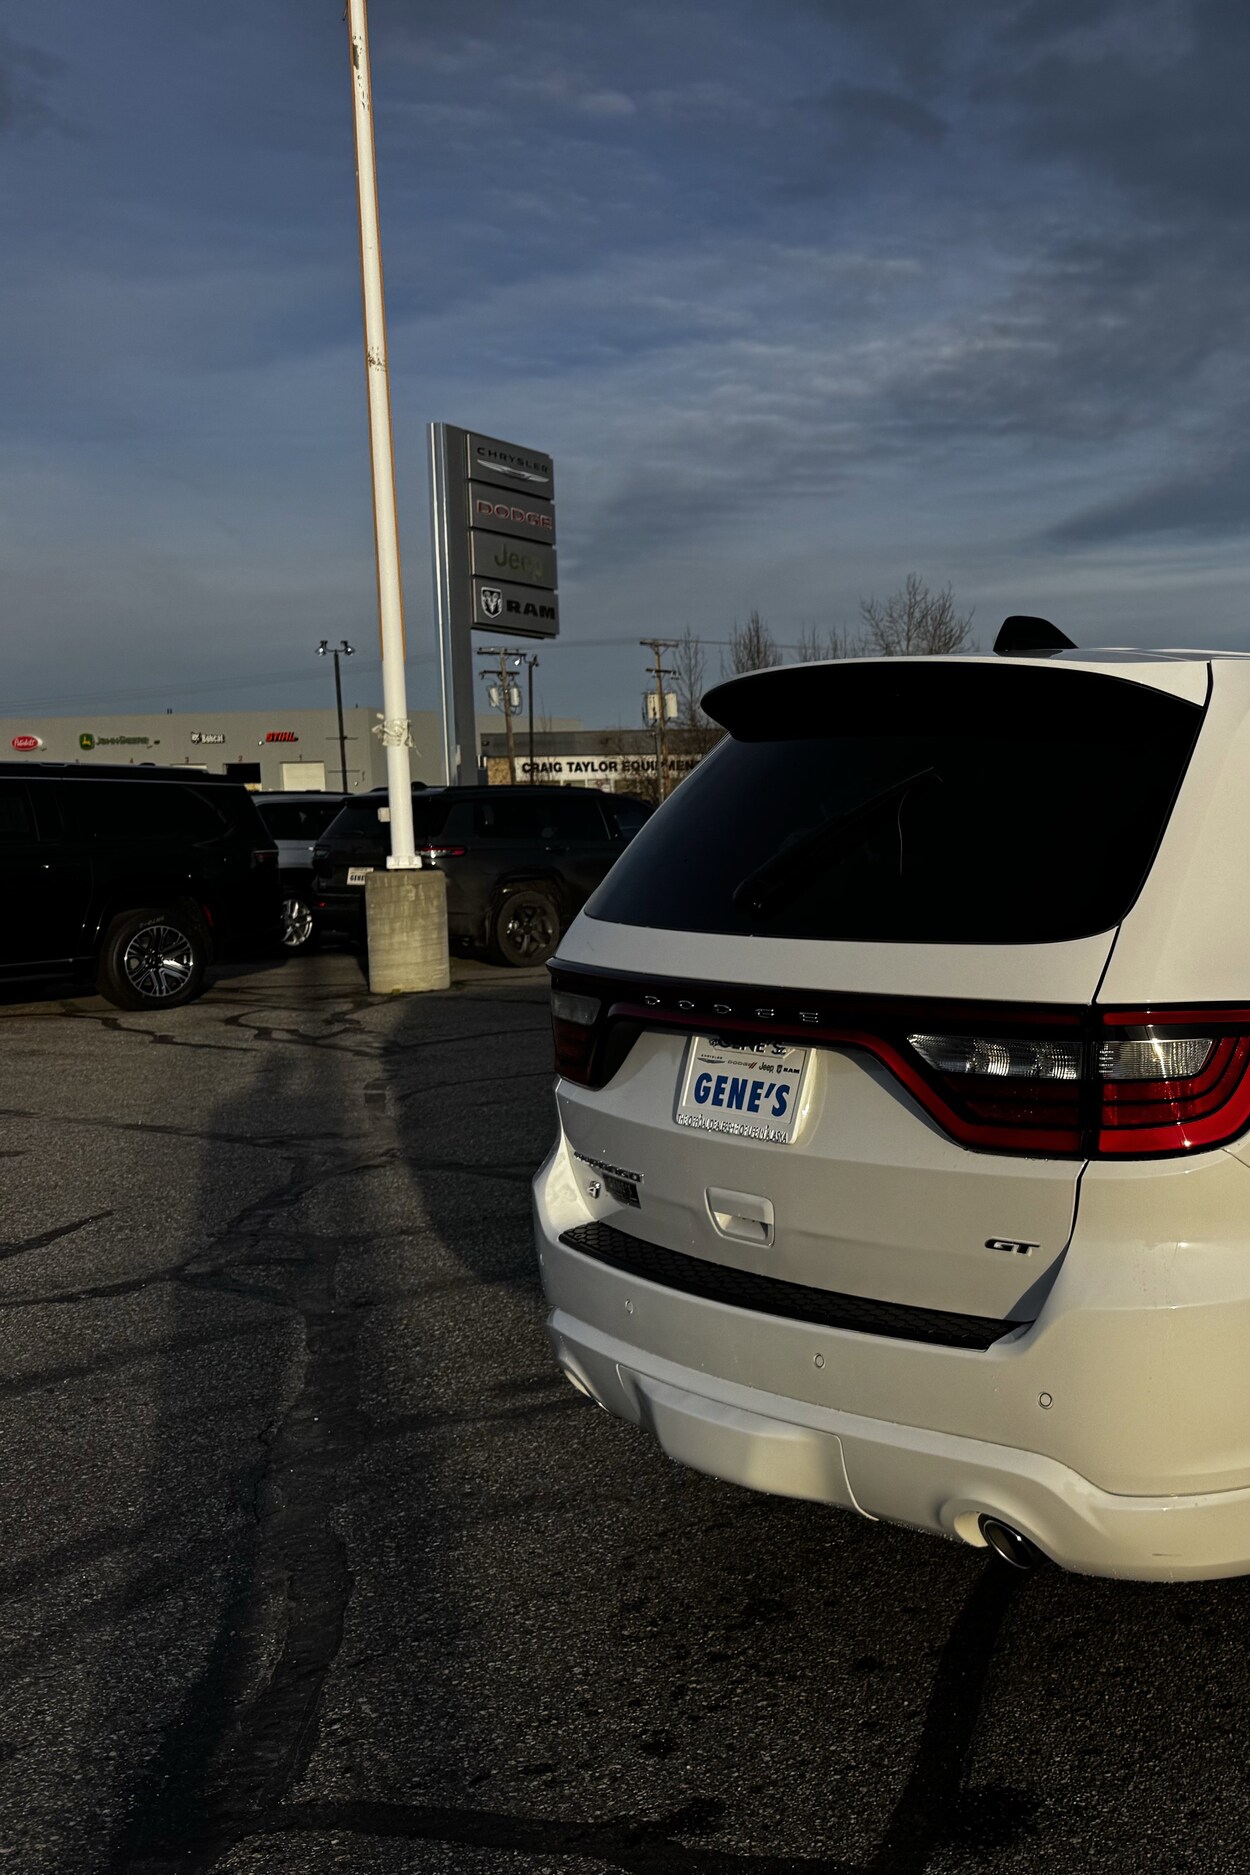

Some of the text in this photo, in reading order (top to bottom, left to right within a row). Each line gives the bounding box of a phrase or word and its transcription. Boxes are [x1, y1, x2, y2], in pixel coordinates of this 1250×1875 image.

[476, 446, 549, 473] CHRYSLER
[476, 499, 552, 530] DODGE
[506, 599, 555, 619] RAM
[522, 759, 700, 773] CRAIG TAYLOR EQUIPMEN
[644, 995, 819, 1023] DODGE
[758, 1061, 774, 1074] Jeep
[694, 1072, 791, 1118] GENE'S
[985, 1238, 1040, 1254] GT
